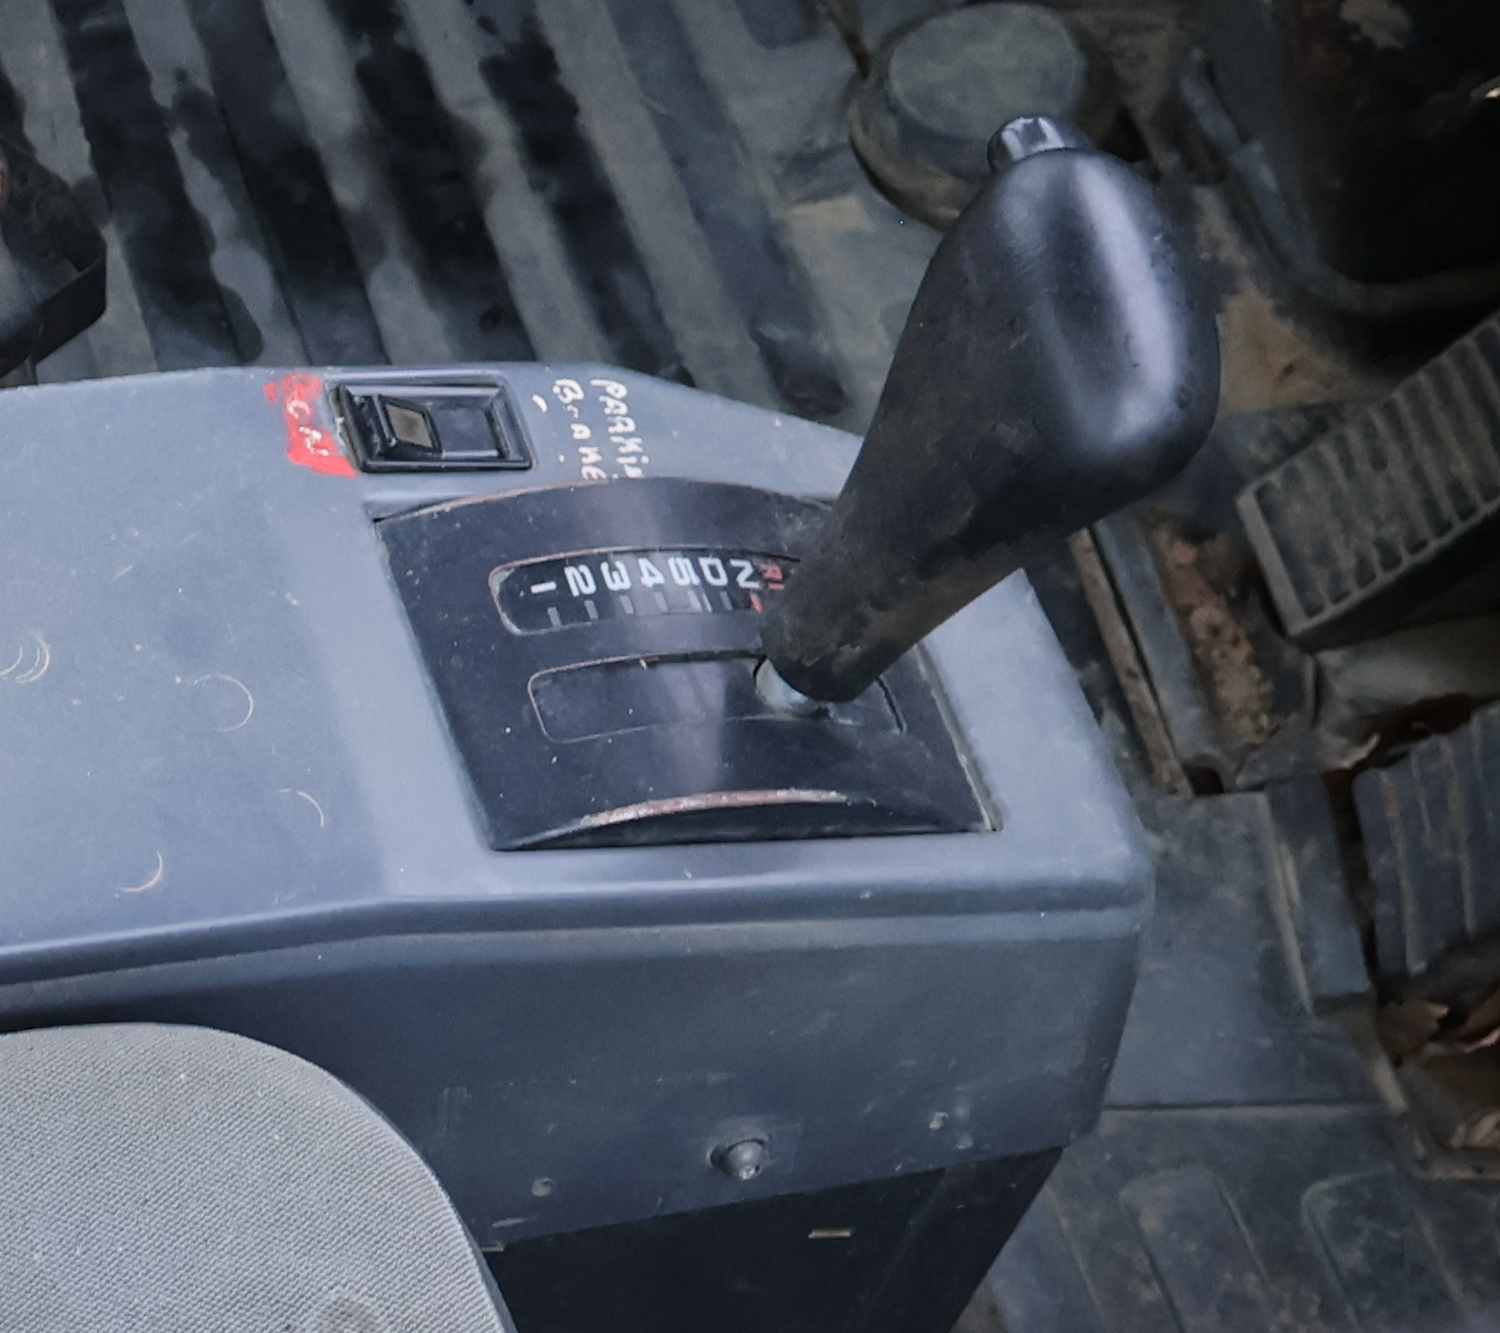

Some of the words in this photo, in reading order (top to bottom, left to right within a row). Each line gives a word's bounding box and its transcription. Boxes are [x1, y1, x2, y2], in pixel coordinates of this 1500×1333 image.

[564, 564, 597, 598] 2
[600, 560, 632, 592] 3
[638, 557, 666, 588] 4
[668, 556, 702, 587] 5
[699, 556, 730, 587] D
[728, 559, 761, 589] N
